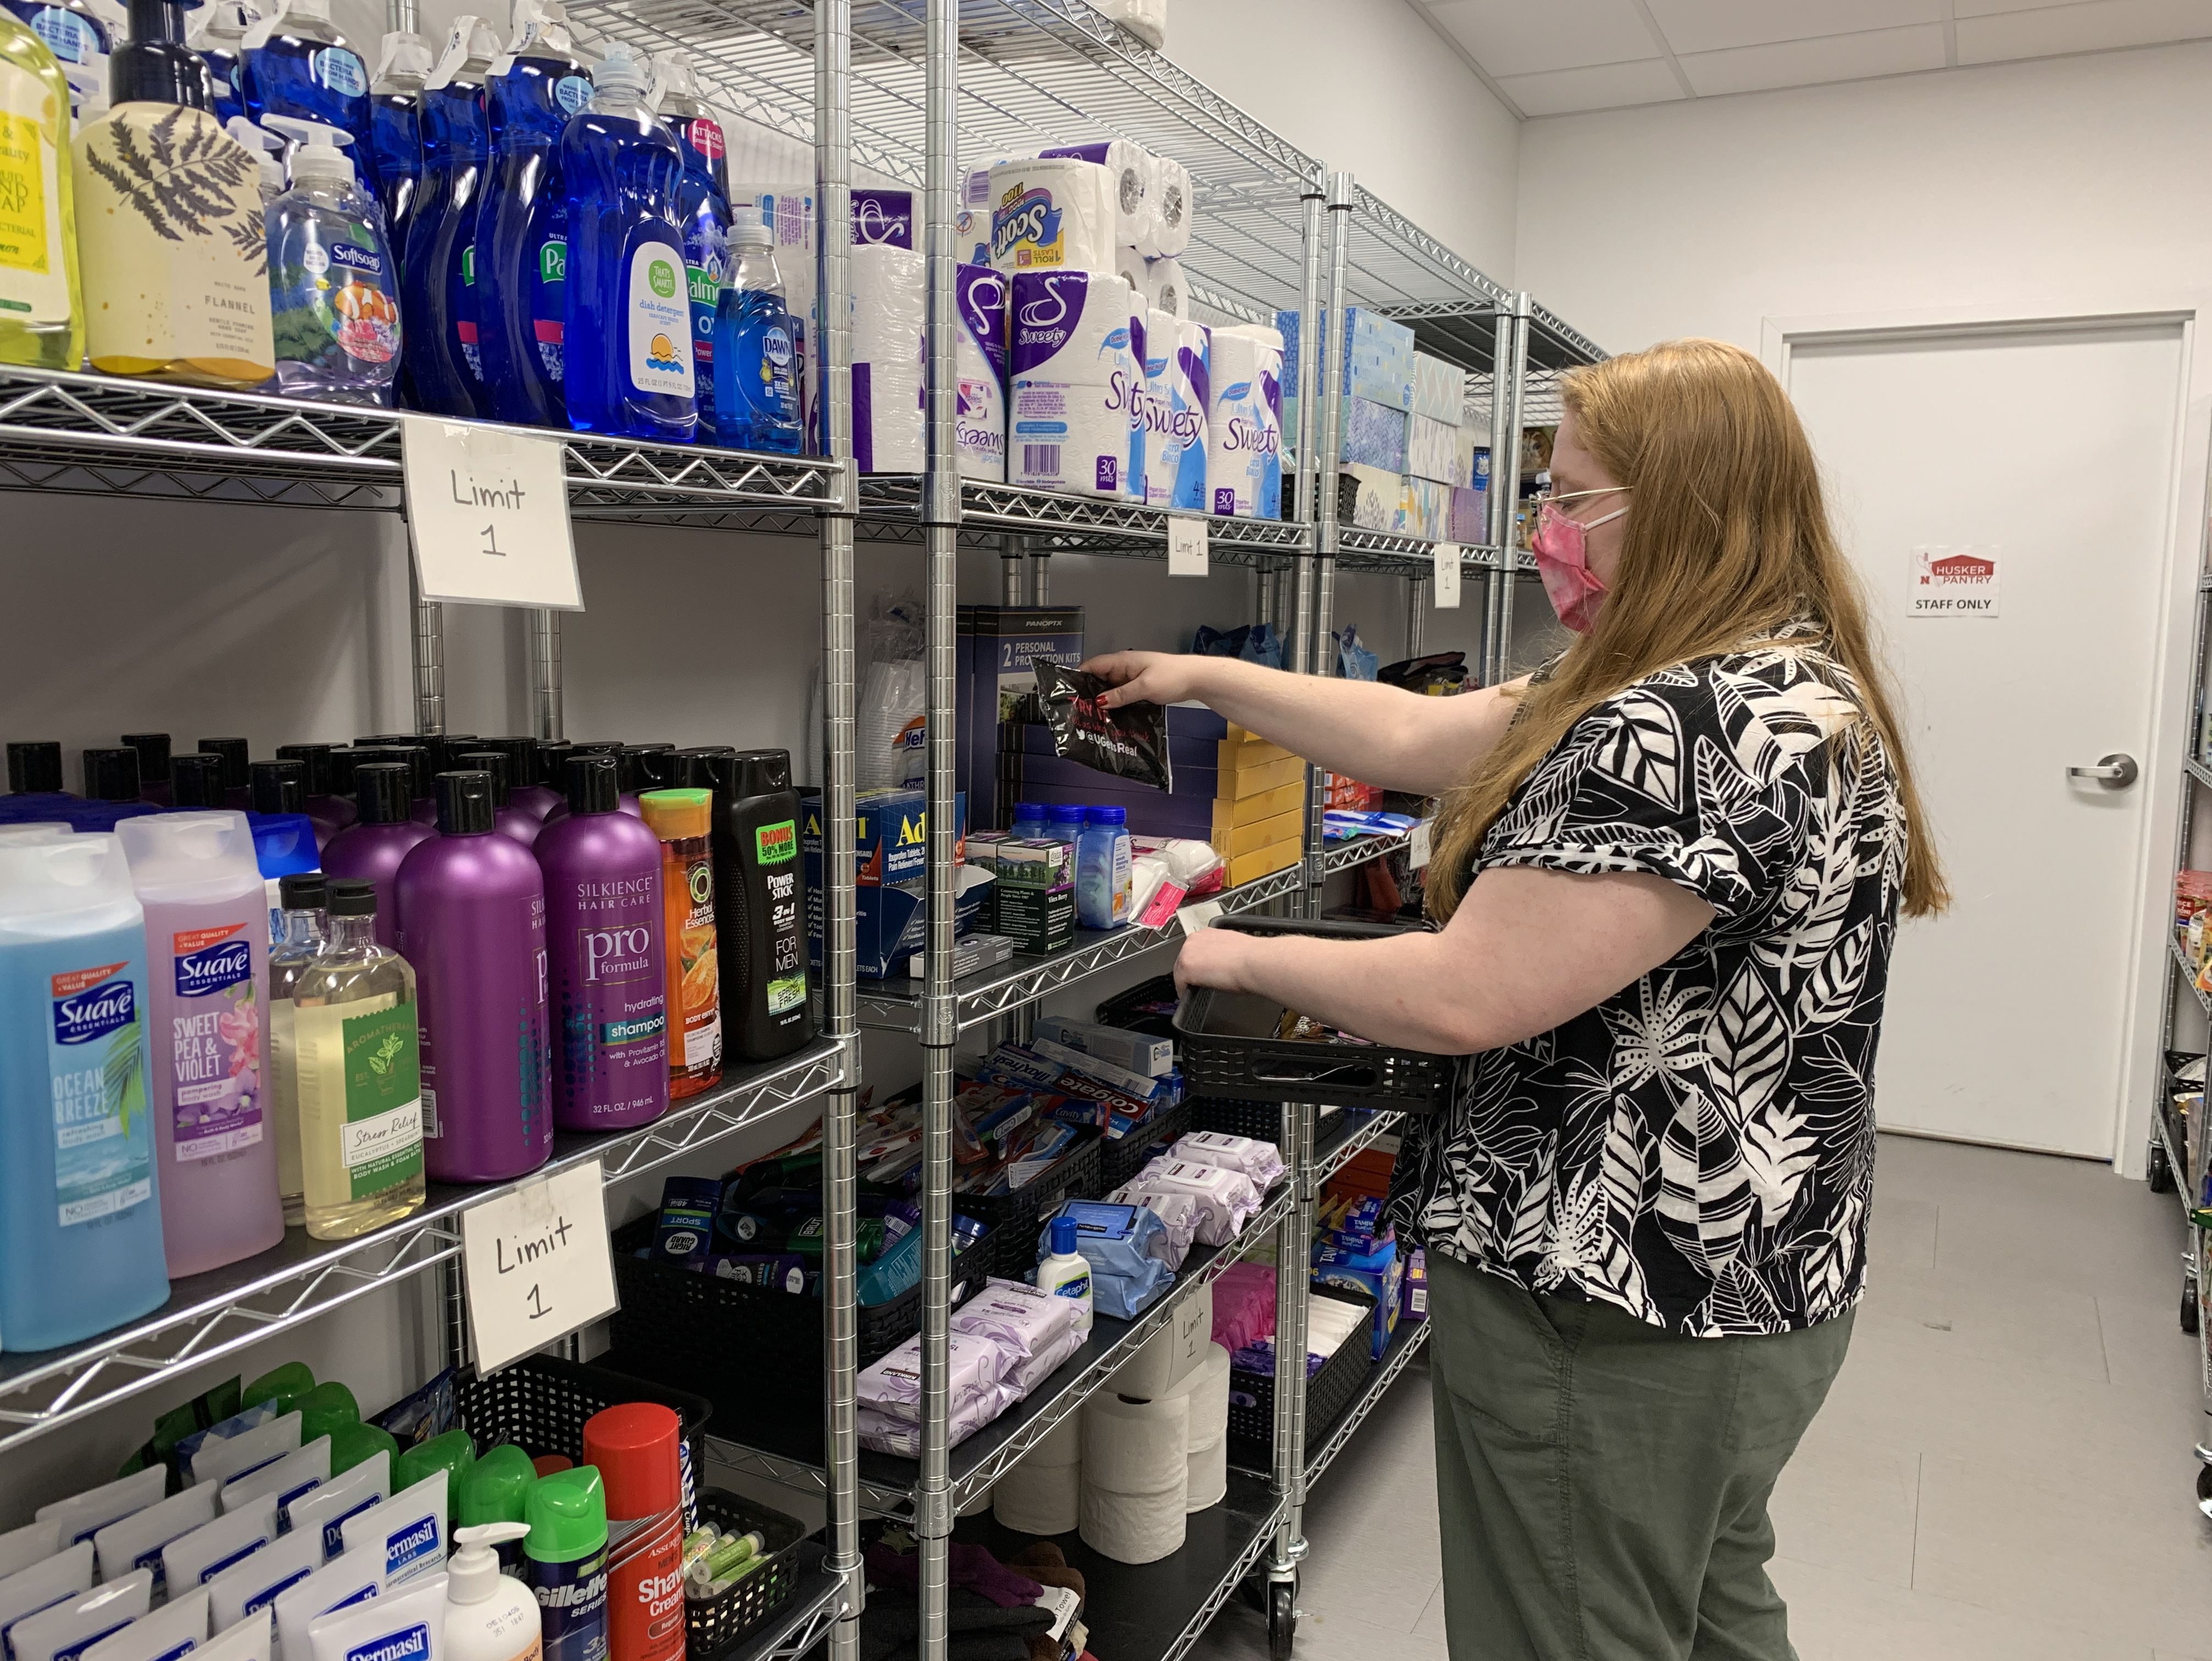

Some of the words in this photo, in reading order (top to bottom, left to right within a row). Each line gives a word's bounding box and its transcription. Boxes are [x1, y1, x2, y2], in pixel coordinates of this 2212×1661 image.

[2, 126, 13, 140] &
[694, 126, 722, 142] ATTACKS
[996, 203, 1047, 260] Scott
[334, 244, 381, 271] Softsoap
[1033, 255, 1054, 264] ROLL
[1055, 250, 1061, 262] 1
[204, 294, 255, 315] FLANNEL
[640, 299, 655, 311] dish
[656, 303, 685, 318] detergent
[1019, 327, 1066, 348] Sweety
[764, 337, 792, 358] DAWN
[957, 421, 1004, 455] Sweety
[1222, 417, 1279, 464] Sweety
[1100, 459, 1116, 477] 30
[1099, 473, 1116, 483] mts
[451, 469, 525, 510] Limit
[1216, 491, 1233, 504] 30
[1217, 503, 1232, 511] mts
[480, 523, 507, 556] 1
[1175, 536, 1193, 555] Limit
[1196, 539, 1203, 556] 1
[1441, 556, 1454, 571] Limit
[1936, 565, 1986, 575] HUSKER
[1444, 576, 1450, 589] 1
[1920, 575, 1931, 585] N
[1943, 576, 1992, 584] PANTRY
[1915, 599, 1953, 610] STAFF
[1957, 599, 1992, 610] ONLY
[1003, 643, 1013, 667] 2
[1015, 642, 1056, 654] PERSONAL
[1065, 652, 1081, 664] KITS
[1086, 731, 1138, 757] @UGetsReal
[760, 829, 793, 847] BONUS
[762, 845, 777, 857] 50%
[778, 841, 794, 853] MORE
[888, 851, 907, 863] Ibuprofen
[888, 861, 898, 872] Pain
[577, 877, 651, 898] SILKIENCE
[767, 872, 794, 890] POWER
[771, 884, 793, 901] STICK
[1048, 895, 1057, 904] Vitex
[1057, 893, 1068, 902] Berry
[578, 899, 615, 911] HAIR
[620, 894, 651, 907] CARE
[688, 901, 713, 919] Herbal
[685, 911, 715, 929] Essences
[773, 917, 785, 926] BODY
[785, 915, 796, 923] WASH
[178, 933, 199, 943] GREAT
[200, 929, 229, 940] QUALITY
[585, 926, 650, 981] pro
[776, 935, 797, 956] FOR
[179, 951, 248, 981] Suave
[601, 956, 650, 974] formula
[775, 951, 799, 972] MEN
[865, 965, 878, 973] EACH
[81, 968, 112, 980] QUALITY
[190, 972, 241, 987] ESSENTIALS
[777, 979, 799, 1000] SPRING
[624, 993, 664, 1013] hydrating
[779, 989, 801, 1010] FRESH
[58, 993, 132, 1027] Suave
[70, 1016, 126, 1033] ESSENTIALS
[173, 1011, 220, 1039] SWEET
[611, 1016, 665, 1038] shampoo
[685, 1014, 702, 1025] BODY
[175, 1041, 201, 1062] PEA
[205, 1036, 218, 1055] &
[609, 1050, 626, 1060] with
[627, 1044, 659, 1057] Provitamin
[175, 1055, 221, 1082] VIOLET
[624, 1060, 631, 1068] &
[633, 1052, 659, 1067] Avocado
[992, 1054, 1052, 1083] Maxfresh
[54, 1067, 104, 1099] OCEAN
[181, 1083, 223, 1097] pampering
[181, 1093, 199, 1103] body
[202, 1089, 222, 1099] wash
[593, 1104, 603, 1113] 32
[603, 1103, 614, 1113] FL.
[614, 1101, 626, 1112] OZ.
[632, 1098, 645, 1108] 946
[645, 1096, 653, 1106] mL
[1060, 1077, 1139, 1114] Colgate
[55, 1092, 109, 1125] BREEZE
[1055, 1107, 1082, 1119] Cavity
[62, 1122, 104, 1138] refreshing
[62, 1134, 82, 1146] body
[85, 1129, 105, 1141] wash
[354, 1129, 388, 1148] Stress
[391, 1111, 419, 1134] Relief
[181, 1143, 198, 1153] NO
[351, 1145, 390, 1161] EUCALYPTUS
[396, 1129, 420, 1146] SPEARMINT
[351, 1163, 366, 1174] WITH
[368, 1156, 391, 1169] NATURAL
[391, 1146, 414, 1162] ESSENTIAL
[353, 1169, 371, 1180] BODY
[373, 1165, 390, 1175] WASH
[396, 1155, 410, 1166] FOAM
[410, 1148, 421, 1159] BATH
[65, 1205, 84, 1217] NO
[671, 1217, 701, 1225] SPORT
[802, 1217, 824, 1236] BRUT
[497, 1216, 573, 1274] Limit
[669, 1242, 692, 1251] RIGHT
[671, 1235, 696, 1245] GUARD
[1340, 1235, 1365, 1245] TAMPAX
[1055, 1279, 1090, 1297] Cetaphil
[527, 1283, 553, 1319] 1
[1183, 1307, 1204, 1340] Limit
[1187, 1340, 1196, 1358] 1
[883, 1369, 918, 1381] KIRKLAND
[386, 1519, 435, 1562] ermasil
[398, 1551, 418, 1566] LABS
[419, 1553, 442, 1569] Research
[533, 1573, 608, 1608] Gillette
[570, 1593, 607, 1618] SERIES
[649, 1586, 684, 1618] Cream
[1055, 1591, 1071, 1612] Towel
[486, 1605, 521, 1630] 0510405
[493, 1626, 506, 1637] 351
[510, 1612, 525, 1627] 1847
[661, 1613, 679, 1630] Regular
[349, 1627, 426, 1661] Dermasil
[523, 1643, 540, 1661] Body
